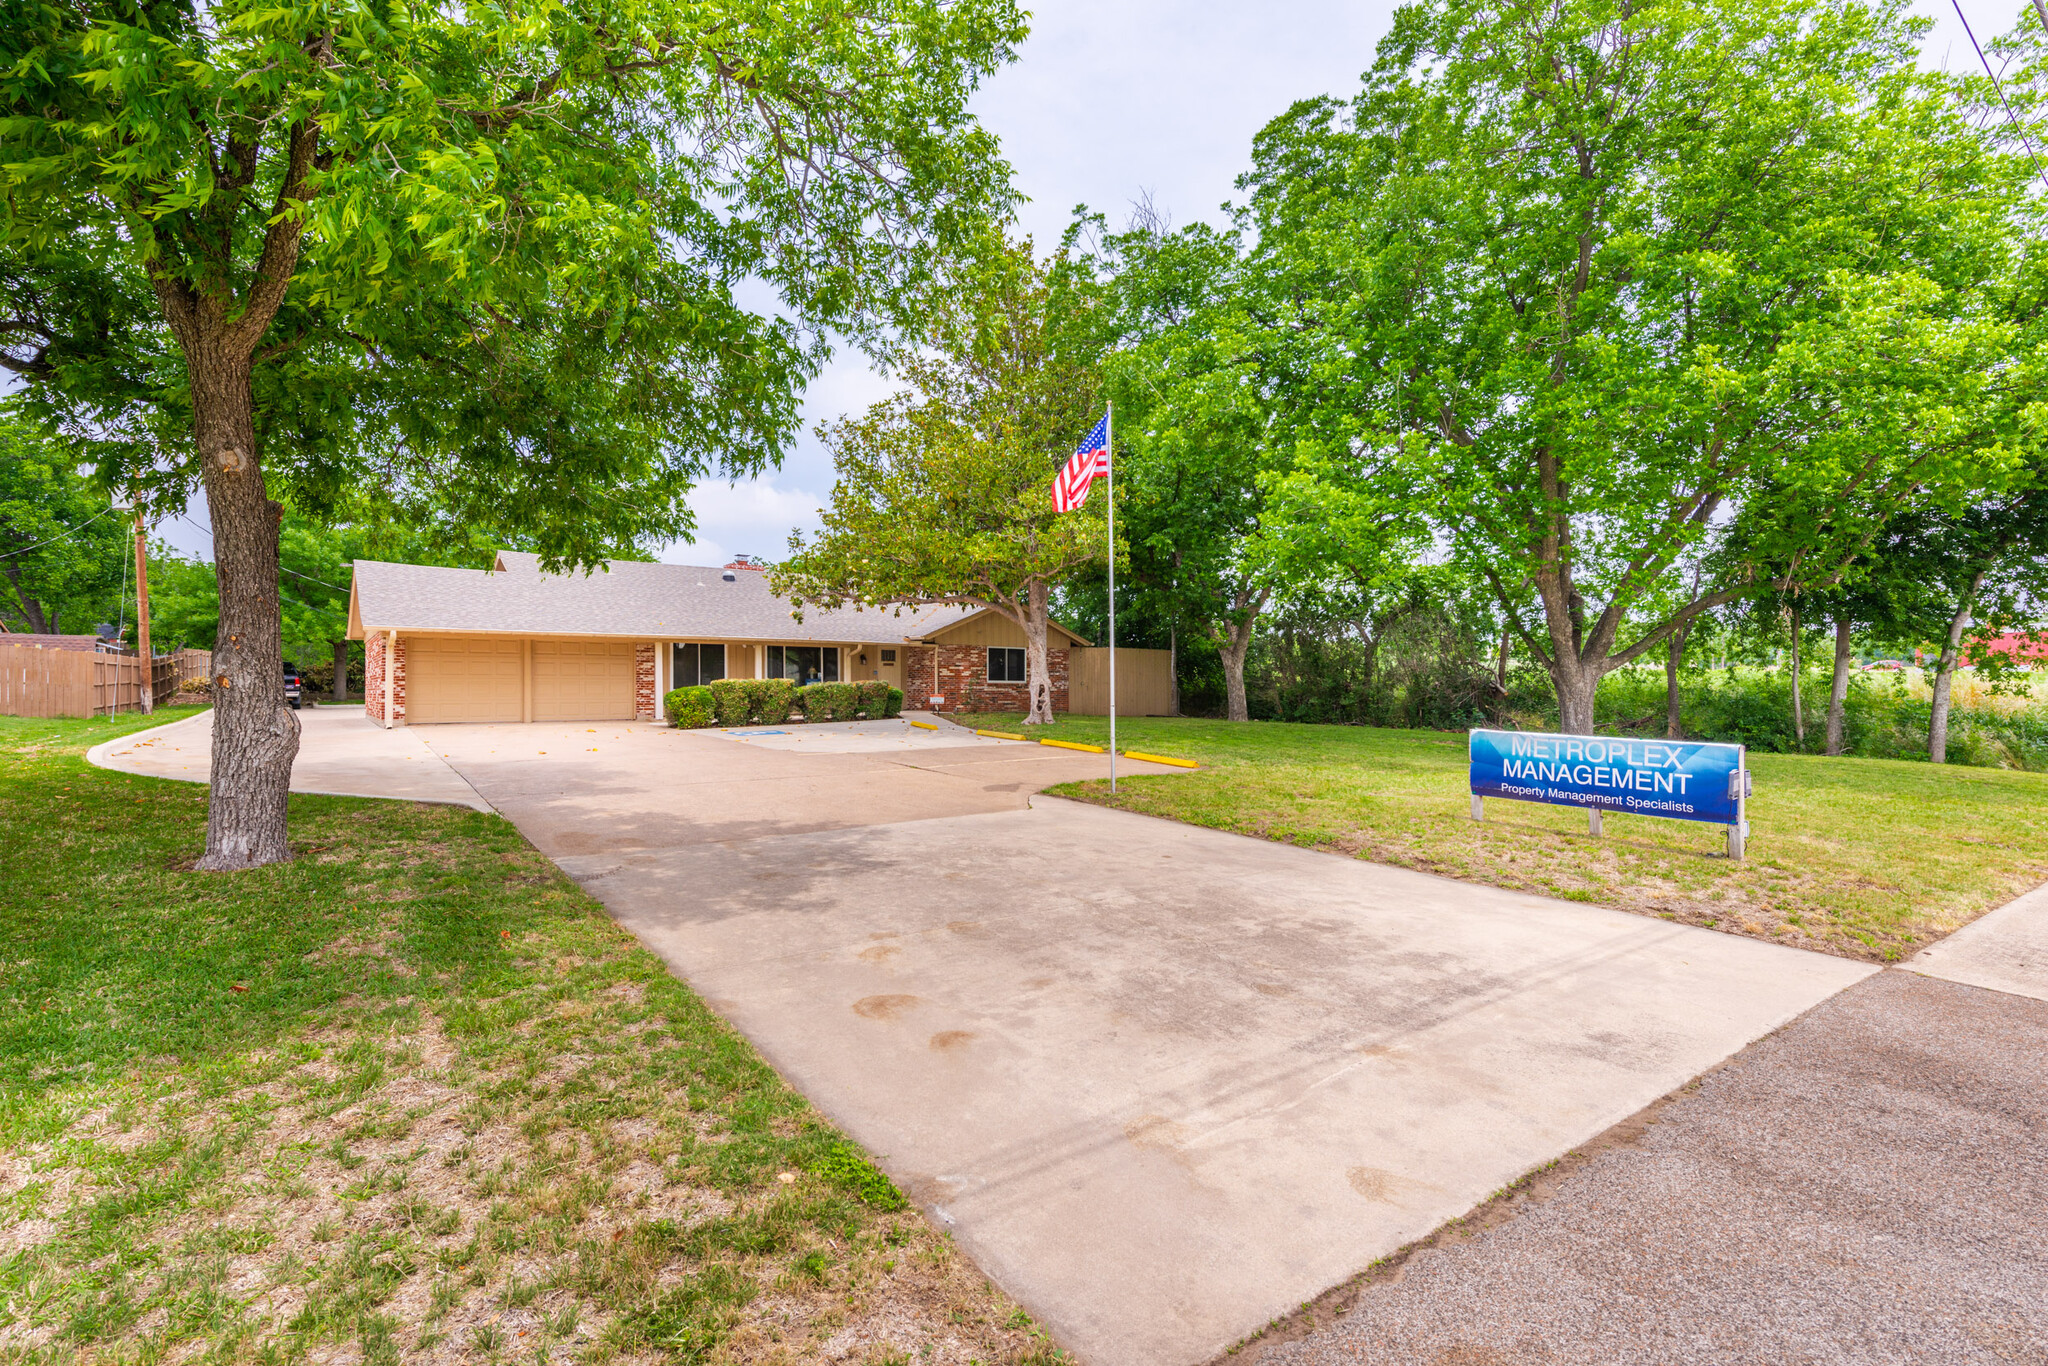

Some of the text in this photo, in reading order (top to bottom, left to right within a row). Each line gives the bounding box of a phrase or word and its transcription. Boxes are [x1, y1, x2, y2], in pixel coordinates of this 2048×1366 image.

[1511, 736, 1683, 769] METROPLEX
[1503, 759, 1693, 795] MANAGEMENT
[1501, 783, 1694, 813] Property Management Specialists
